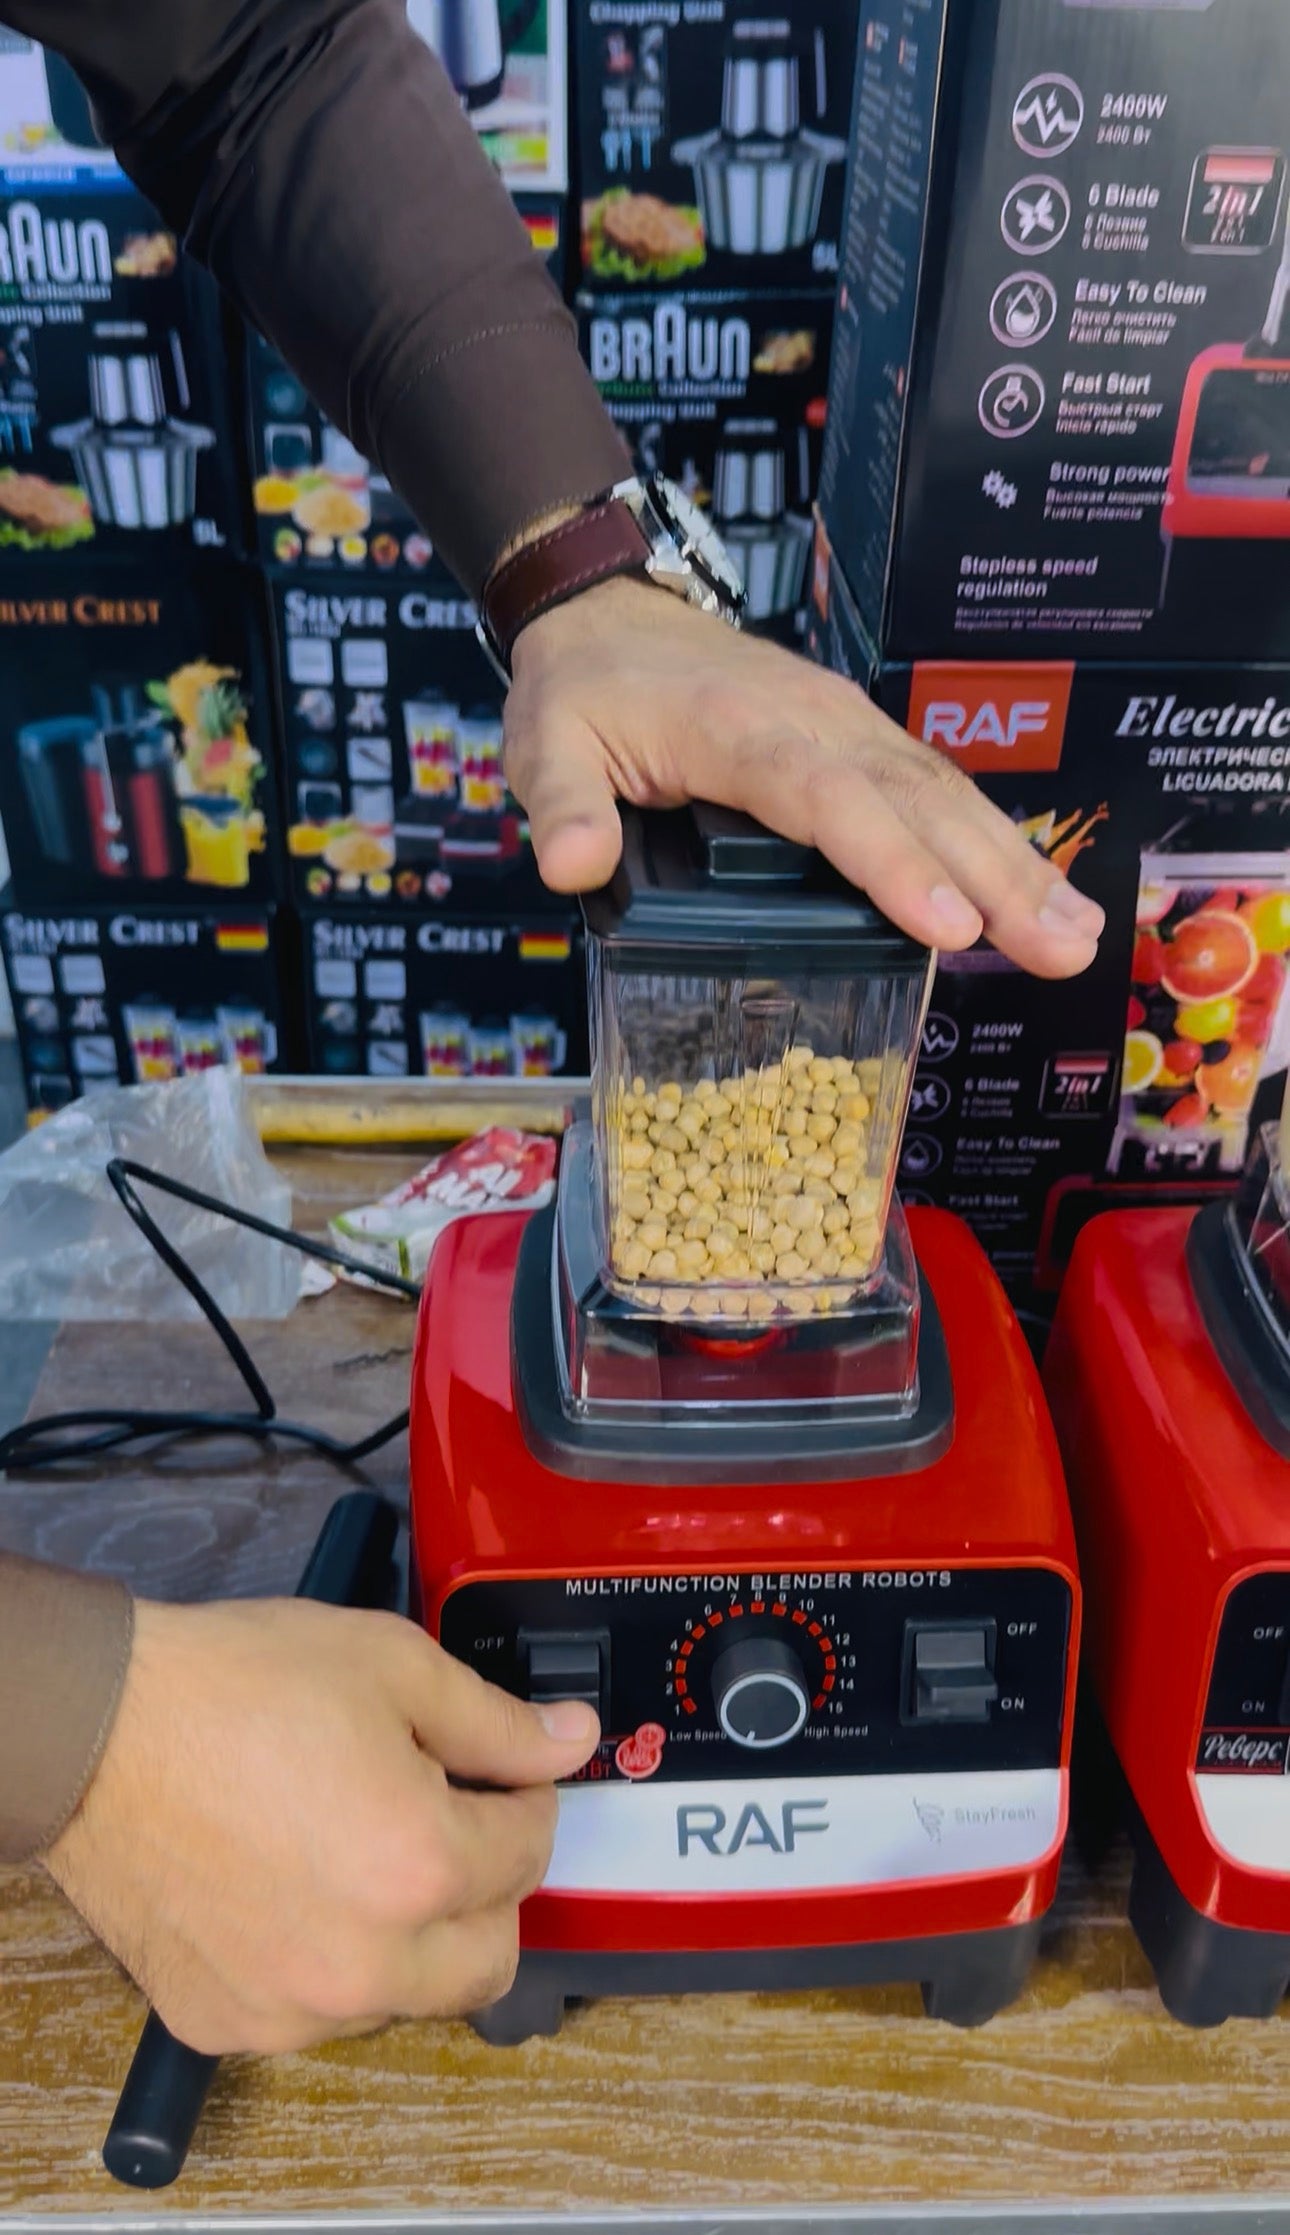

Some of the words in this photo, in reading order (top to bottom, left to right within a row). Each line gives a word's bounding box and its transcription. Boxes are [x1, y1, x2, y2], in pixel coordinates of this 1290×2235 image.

[1100, 93, 1168, 119] 2400W
[1105, 182, 1160, 209] Blade
[1074, 278, 1122, 307] Easy
[1126, 280, 1149, 303] To
[1153, 280, 1208, 304] Clean
[1061, 371, 1102, 394] Fast
[1106, 372, 1151, 395] Start
[1050, 461, 1111, 485] Strong
[1113, 465, 1171, 485] power
[960, 555, 1038, 577] Stepless
[1042, 556, 1099, 578] speed
[957, 579, 1048, 602] regulation
[399, 592, 479, 629] CRES
[922, 702, 1050, 746] RAF
[1115, 693, 1290, 740] Electric
[1147, 746, 1290, 767] ЭЛЕКТРИЧЕС
[972, 1023, 1024, 1038] 2400W
[977, 1077, 1020, 1092] Blade
[956, 1137, 992, 1152] Easy
[1018, 1136, 1061, 1150] Clean
[566, 1576, 740, 1596] MULTIFUNCTION
[751, 1573, 851, 1592] BLENDER
[862, 1571, 951, 1589] ROBOTS
[799, 1598, 814, 1611] 10
[822, 1613, 835, 1626] 11
[1007, 1622, 1038, 1636] OFF
[1253, 1626, 1284, 1640] OFF
[474, 1636, 504, 1650] OFF
[670, 1639, 678, 1651] 4
[835, 1632, 850, 1646] 12
[841, 1654, 856, 1668] 13
[666, 1682, 673, 1695] 2
[840, 1678, 854, 1690] 14
[829, 1701, 843, 1714] 15
[1001, 1697, 1024, 1710] ON
[1241, 1700, 1265, 1713] ON
[670, 1730, 691, 1741] Low
[804, 1727, 829, 1738] High
[834, 1725, 868, 1737] Speed
[1204, 1733, 1283, 1768] Реверс
[955, 1806, 1036, 1827] StayFresh
[676, 1799, 829, 1857] RAF
